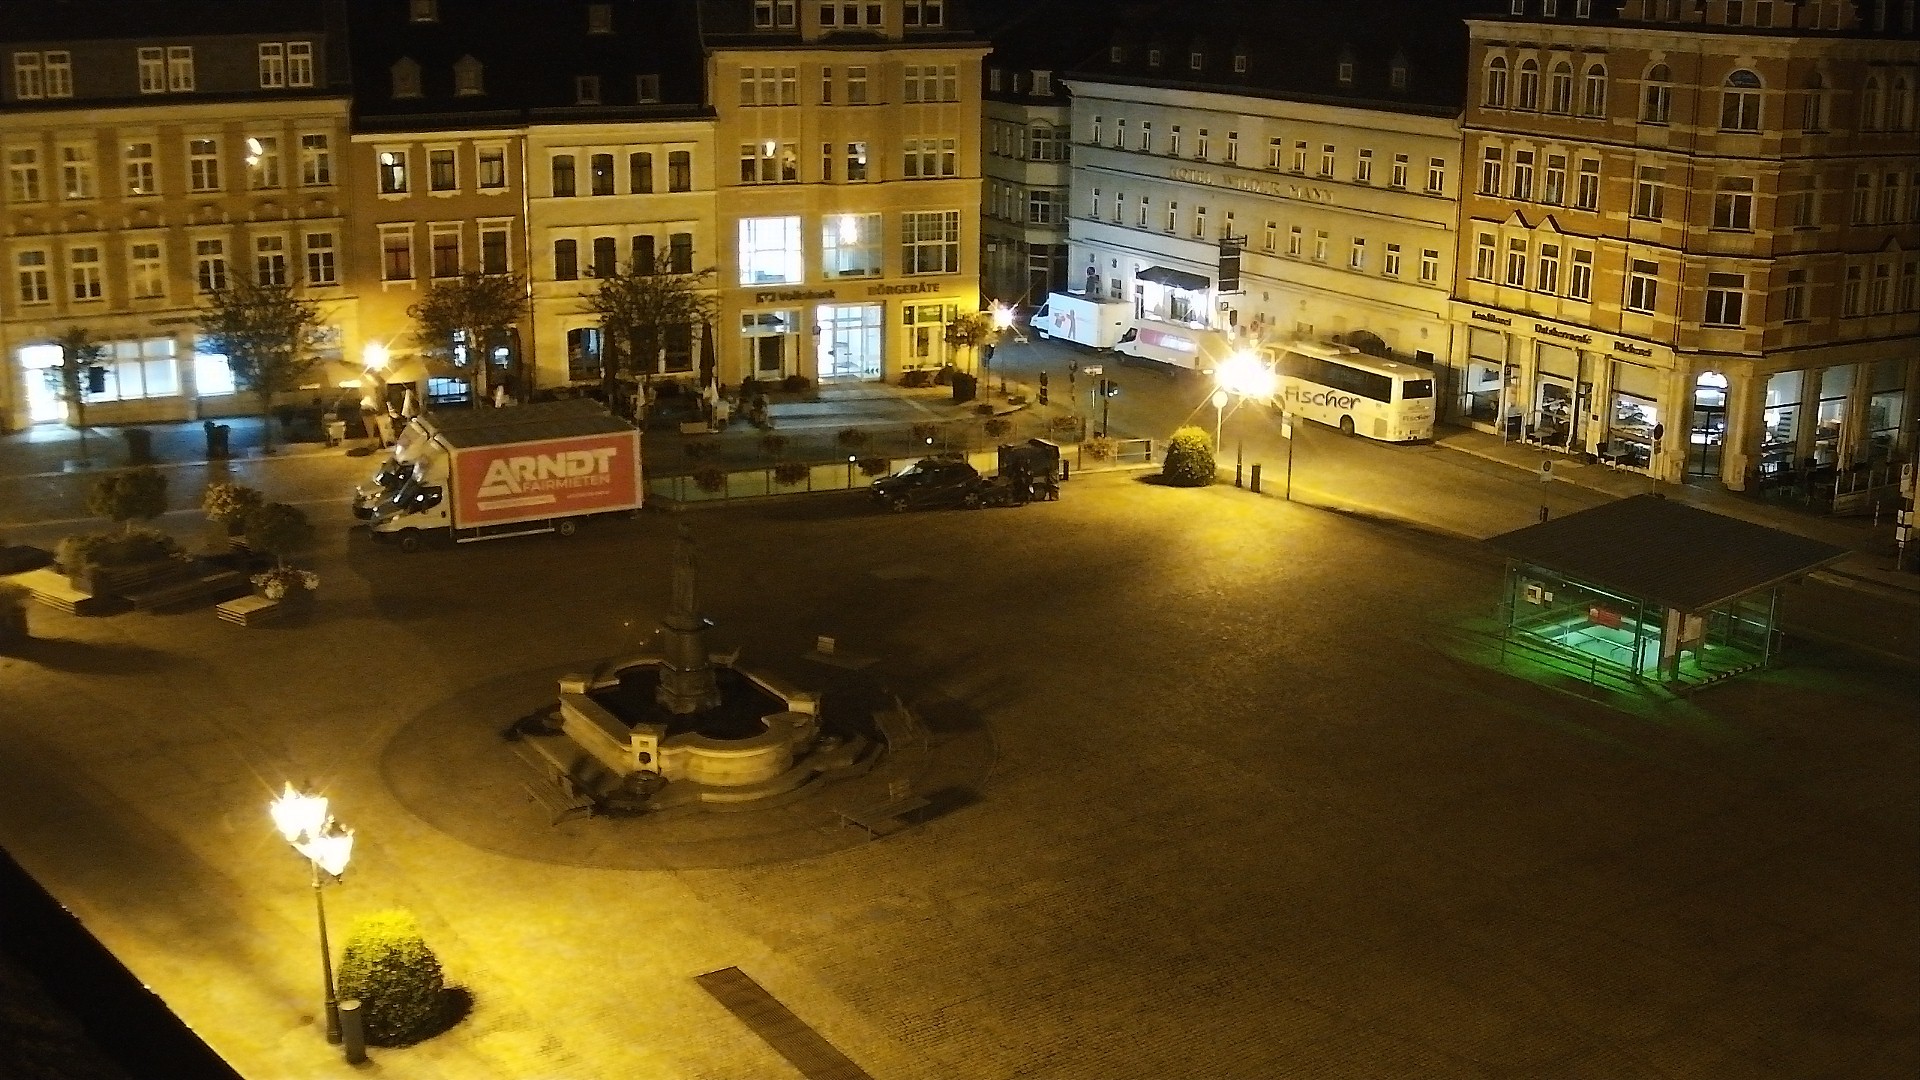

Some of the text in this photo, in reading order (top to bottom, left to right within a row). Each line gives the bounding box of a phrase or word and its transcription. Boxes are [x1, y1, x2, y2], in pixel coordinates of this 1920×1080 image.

[1284, 385, 1361, 410] Fischer
[477, 447, 617, 498] ARNDT
[523, 473, 611, 493] FAIRMIETEN
